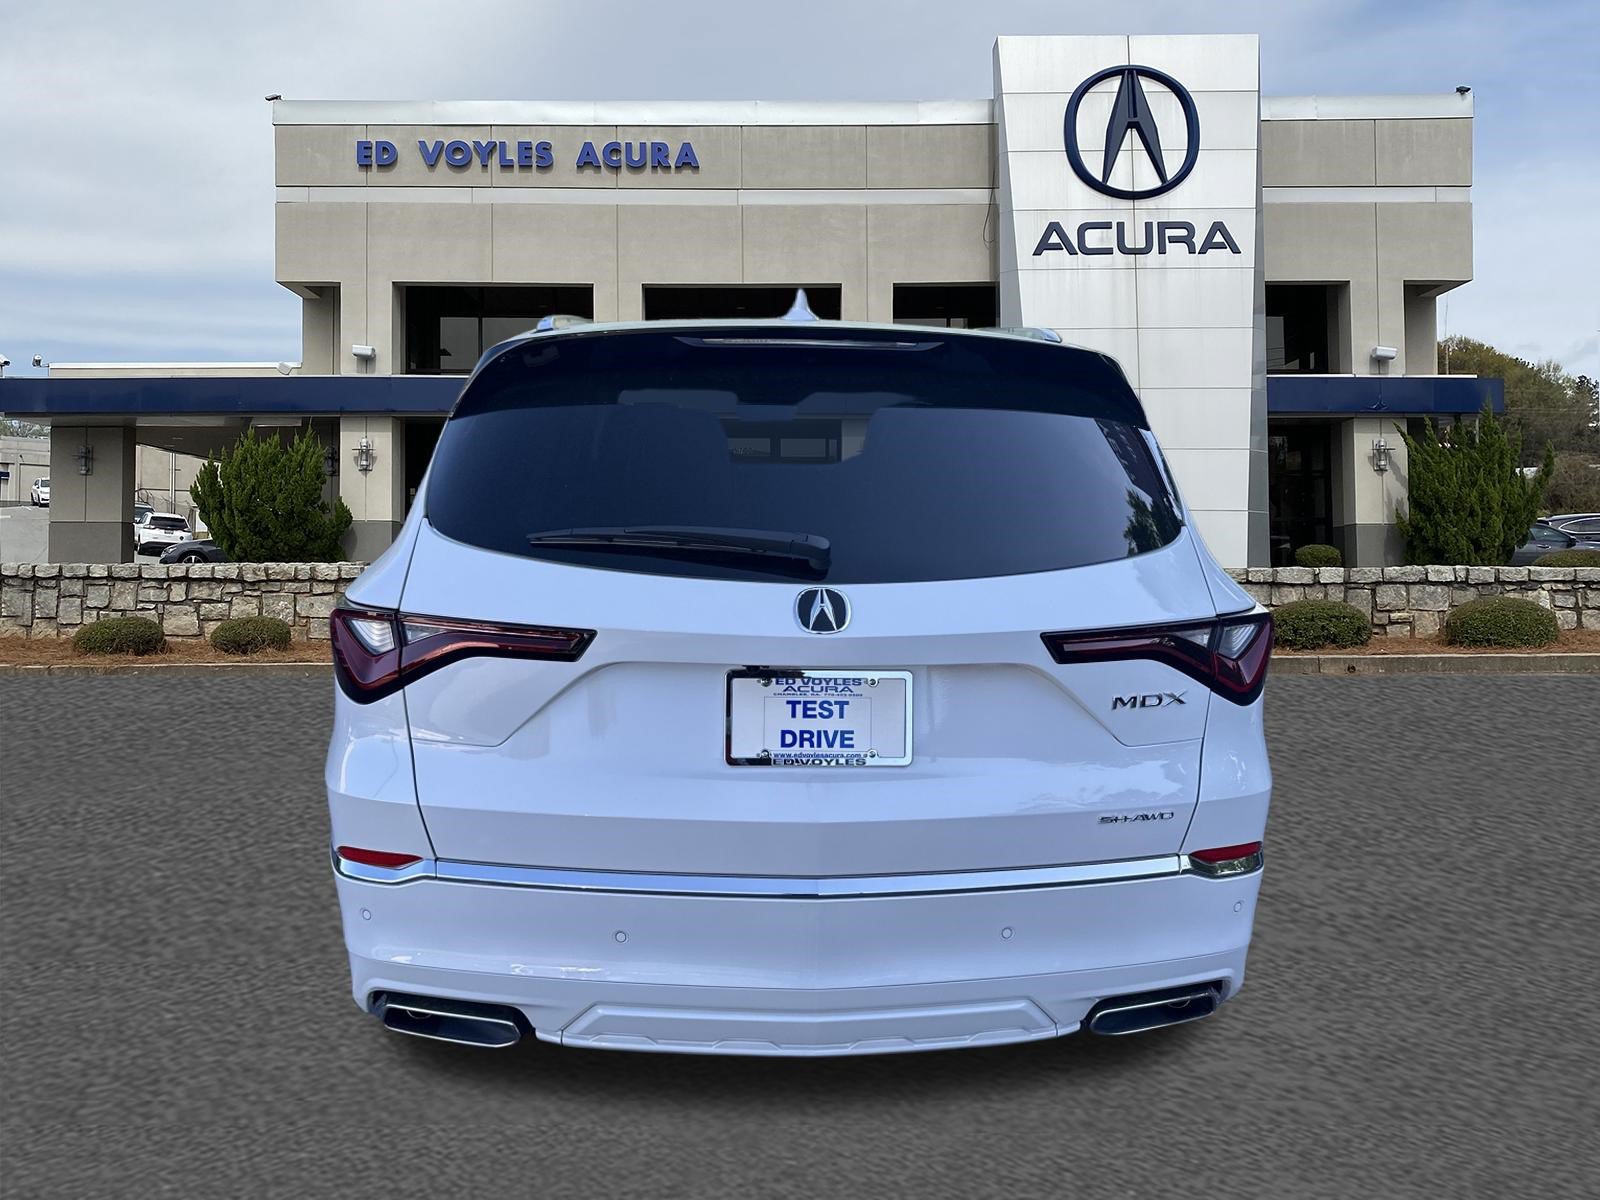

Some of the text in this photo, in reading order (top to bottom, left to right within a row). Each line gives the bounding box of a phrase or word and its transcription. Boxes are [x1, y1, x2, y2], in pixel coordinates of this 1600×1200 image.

[356, 140, 700, 169] ED VOYLES ACURA
[1032, 221, 1242, 256] ACURA
[775, 677, 862, 686] ED VOYLES
[782, 685, 853, 693] ACURA
[785, 699, 850, 719] TEST
[1111, 690, 1188, 710] MDX
[780, 729, 855, 749] DRIVE
[799, 758, 866, 766] VOYLES
